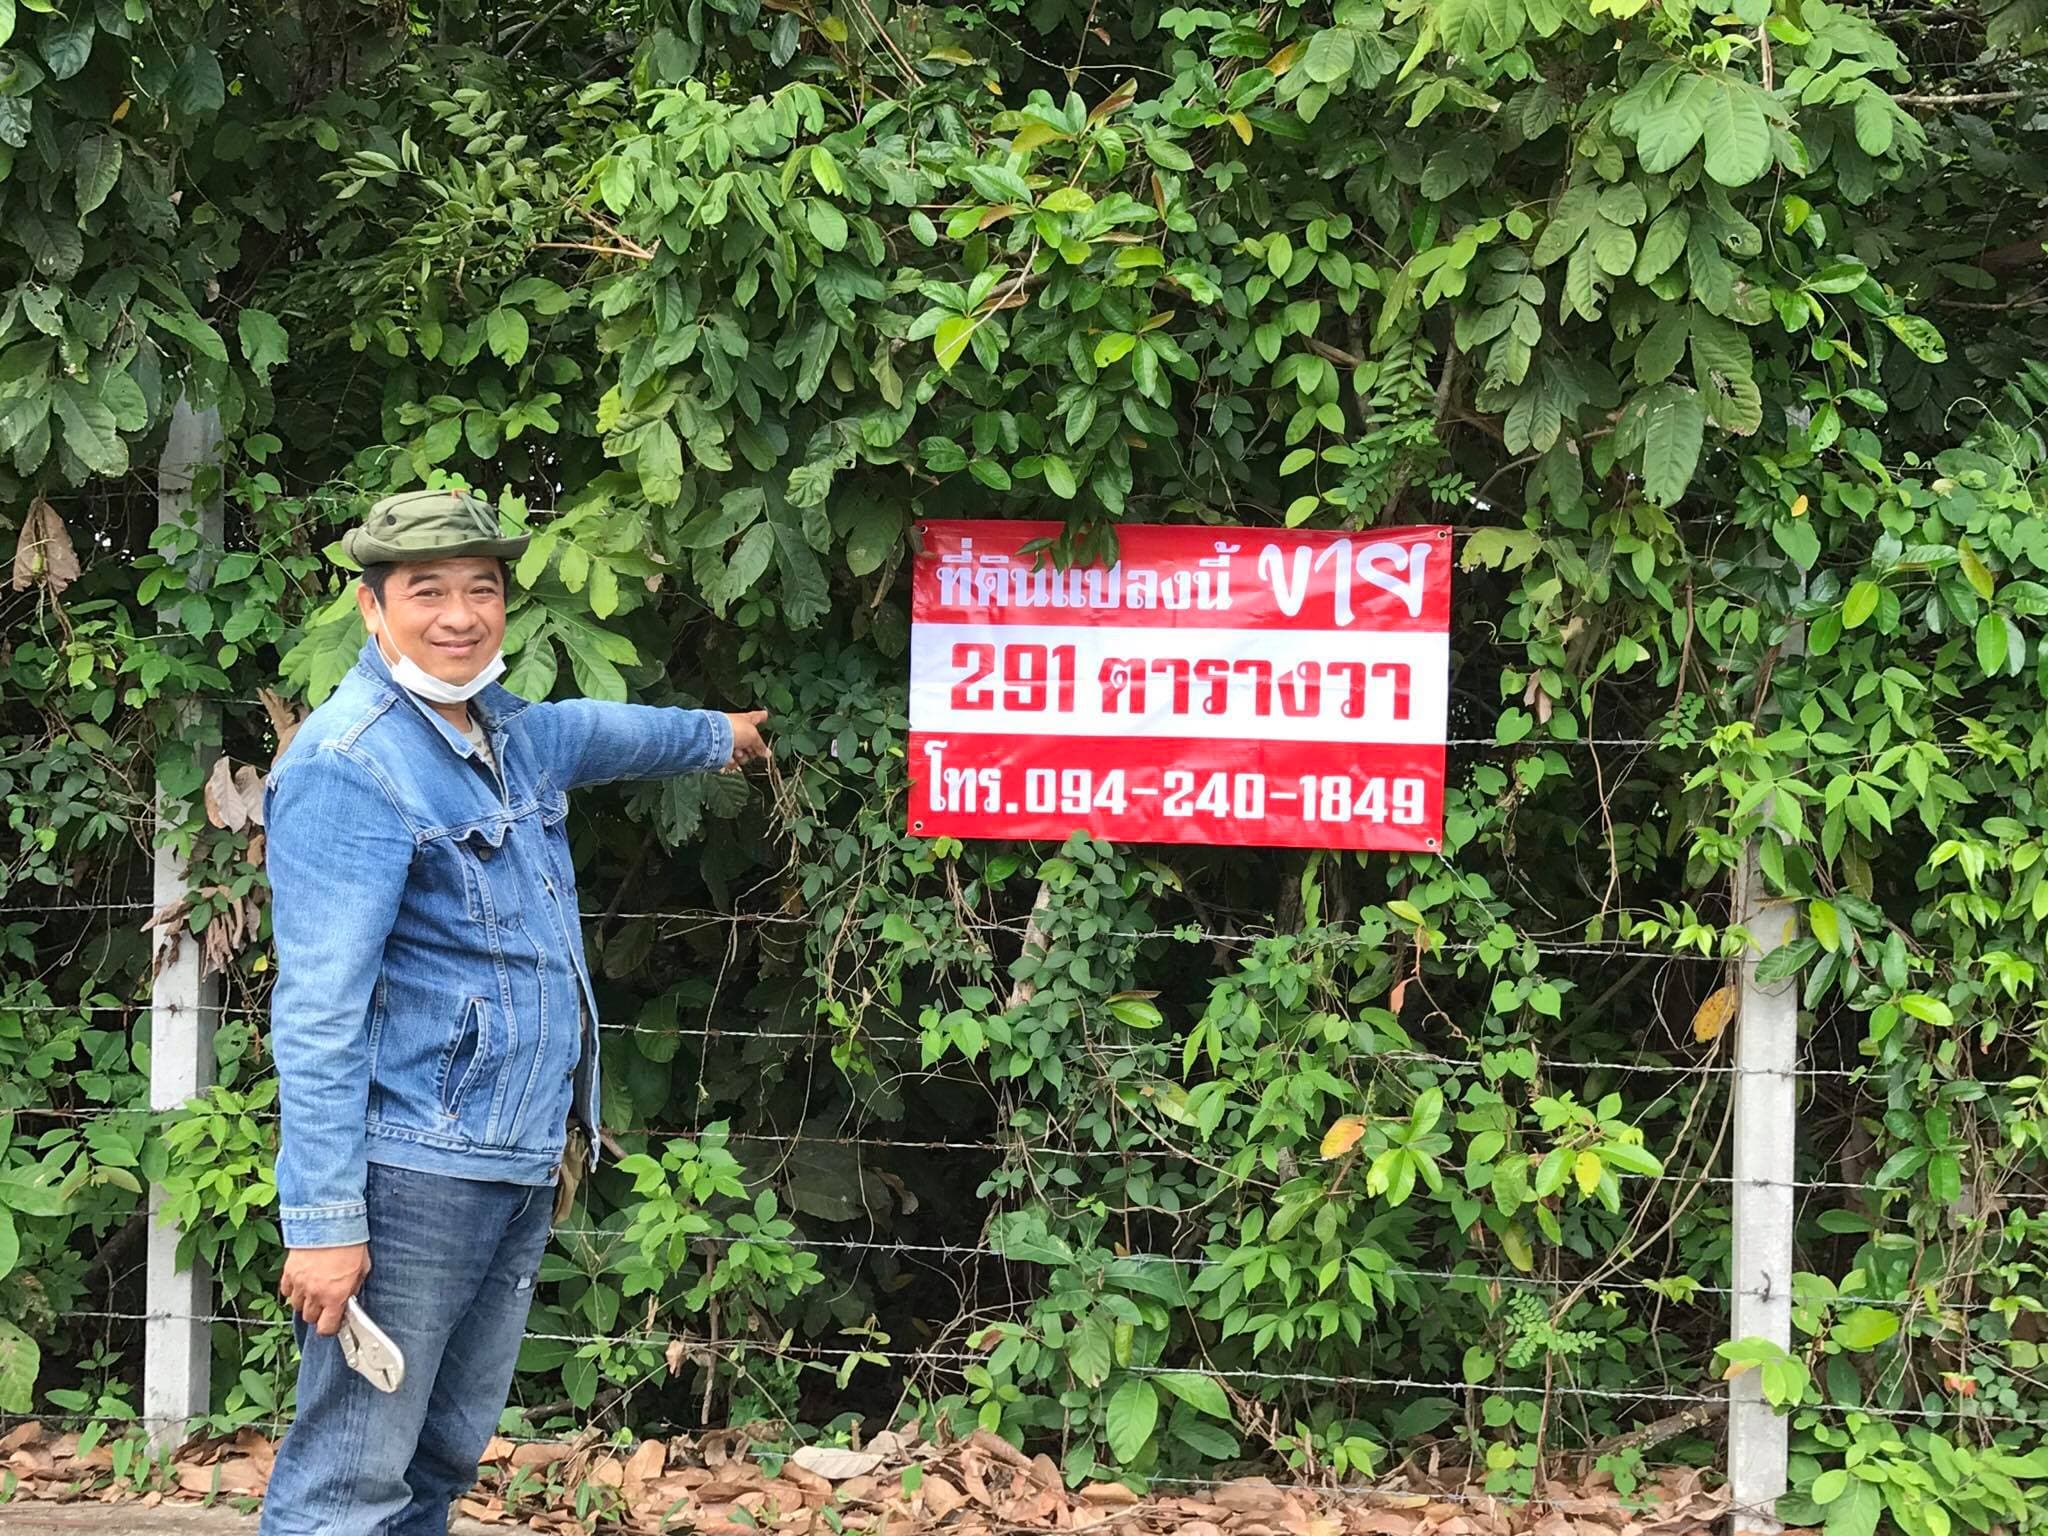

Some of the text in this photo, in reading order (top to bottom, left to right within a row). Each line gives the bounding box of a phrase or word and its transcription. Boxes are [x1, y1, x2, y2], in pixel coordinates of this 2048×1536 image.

[936, 537, 1432, 627] ที่ดินแปลงนี้ ขาย
[950, 642, 1411, 721] 291 ตารางวา
